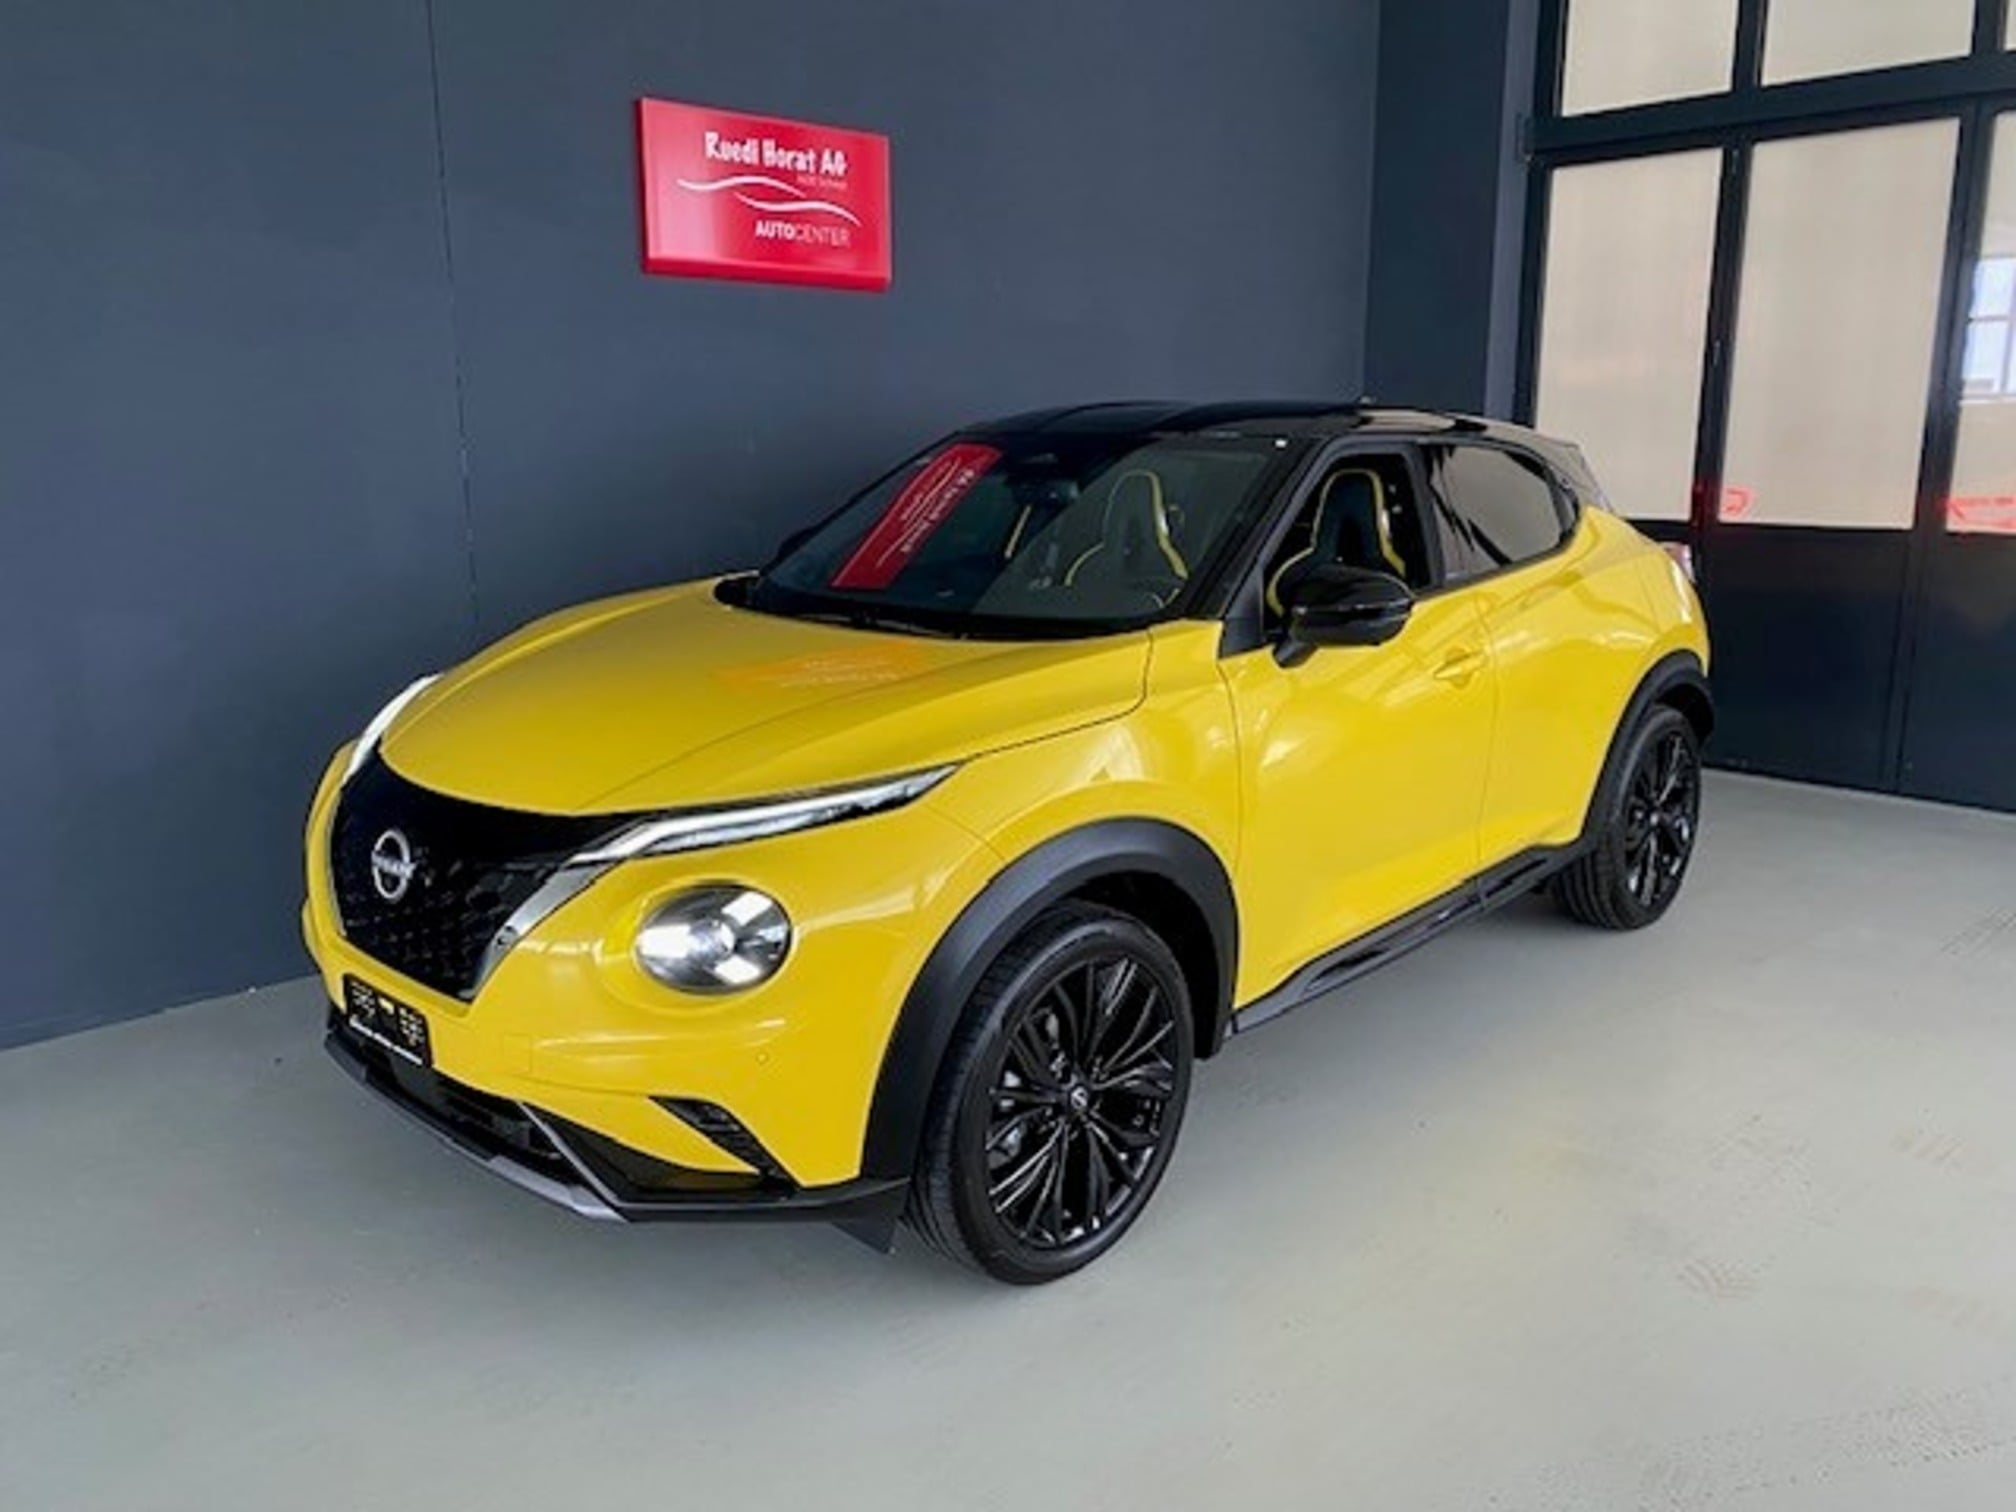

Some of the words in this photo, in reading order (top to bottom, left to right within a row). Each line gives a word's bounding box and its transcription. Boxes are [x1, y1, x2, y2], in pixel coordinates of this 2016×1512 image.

[704, 131, 759, 165] Ruedi
[762, 138, 816, 173] Horat
[820, 148, 847, 176] AG
[755, 220, 850, 247] AUTOCENTER
